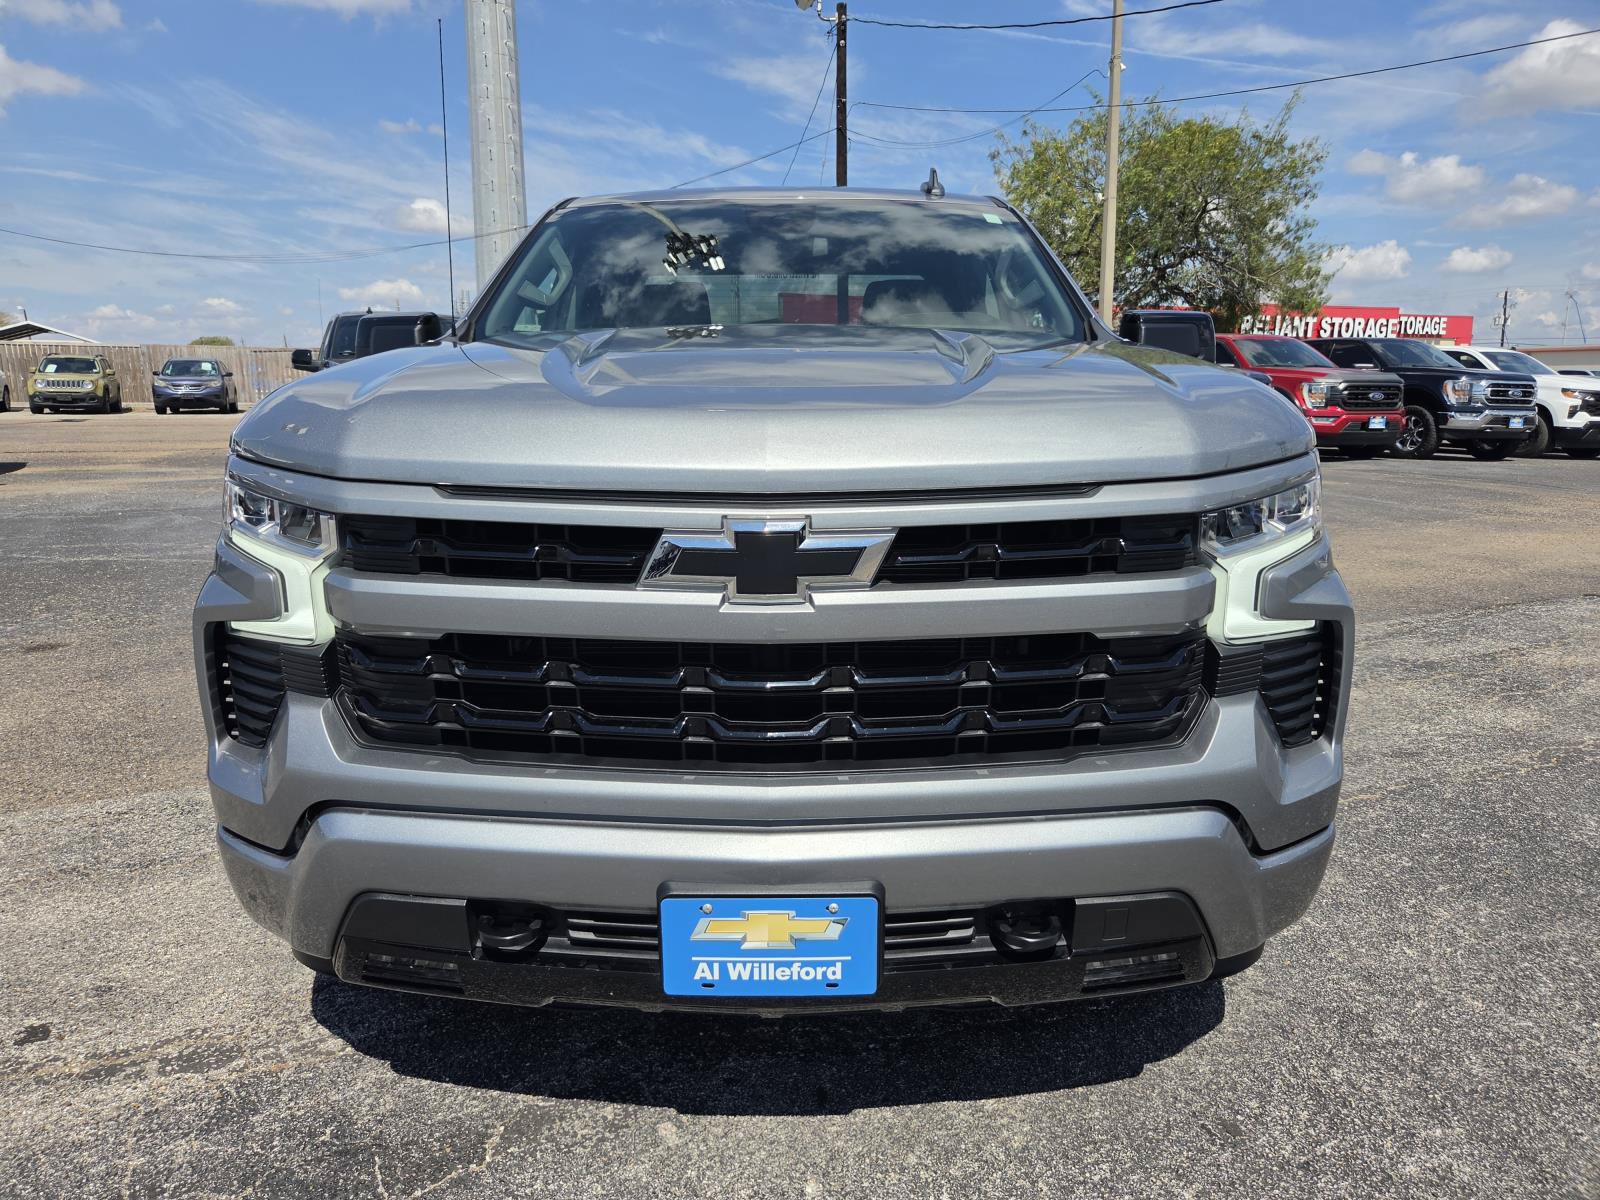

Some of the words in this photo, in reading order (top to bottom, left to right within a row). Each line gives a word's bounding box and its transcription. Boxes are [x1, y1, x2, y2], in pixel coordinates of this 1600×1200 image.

[1319, 316, 1398, 339] STORAGE
[1397, 316, 1448, 336] TORAGE
[693, 962, 720, 981] Al
[727, 962, 843, 981] Willeford
